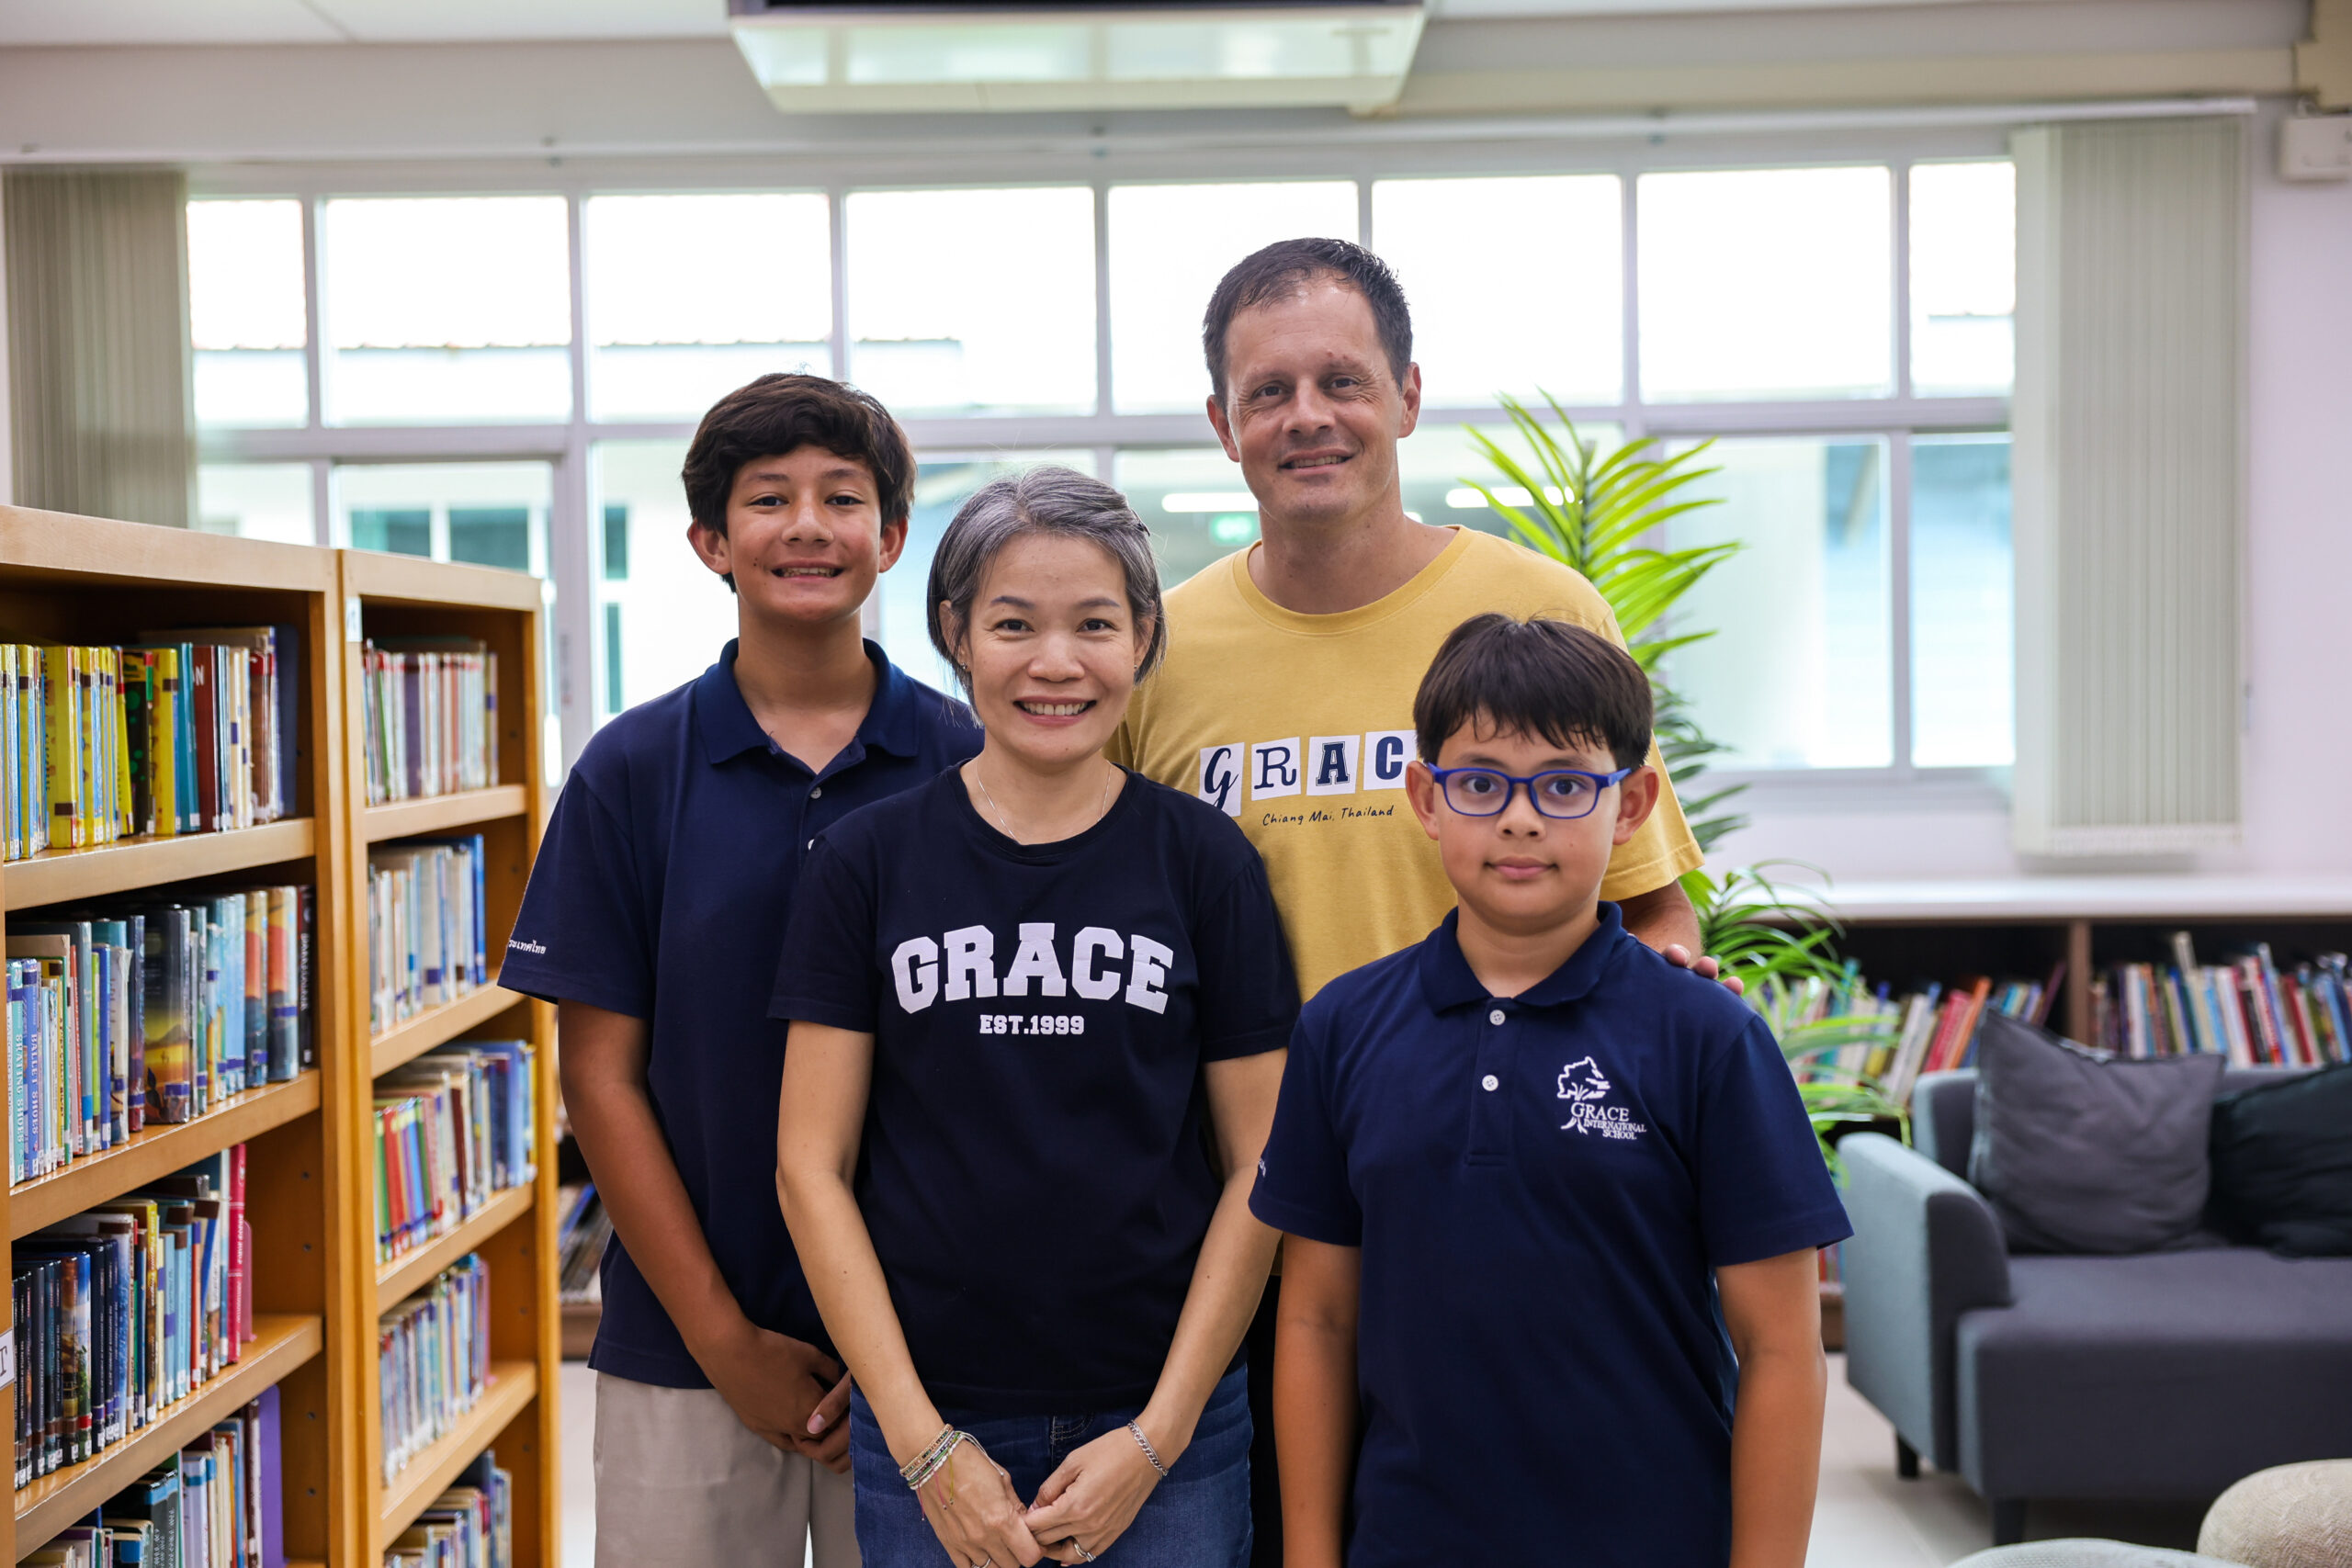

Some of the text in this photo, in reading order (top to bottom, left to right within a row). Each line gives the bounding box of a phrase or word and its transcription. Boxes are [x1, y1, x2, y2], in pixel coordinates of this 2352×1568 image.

[1204, 736, 1404, 810] GRAC
[1262, 813, 1304, 826] Chiang
[1341, 805, 1394, 820] Thailand
[891, 922, 1173, 1014] GRACE
[979, 1014, 1084, 1034] EST.1999
[1570, 1101, 1630, 1122] GRACE
[1583, 1118, 1646, 1133] INTERNATIONAL
[1602, 1130, 1637, 1140] SCHOOL
